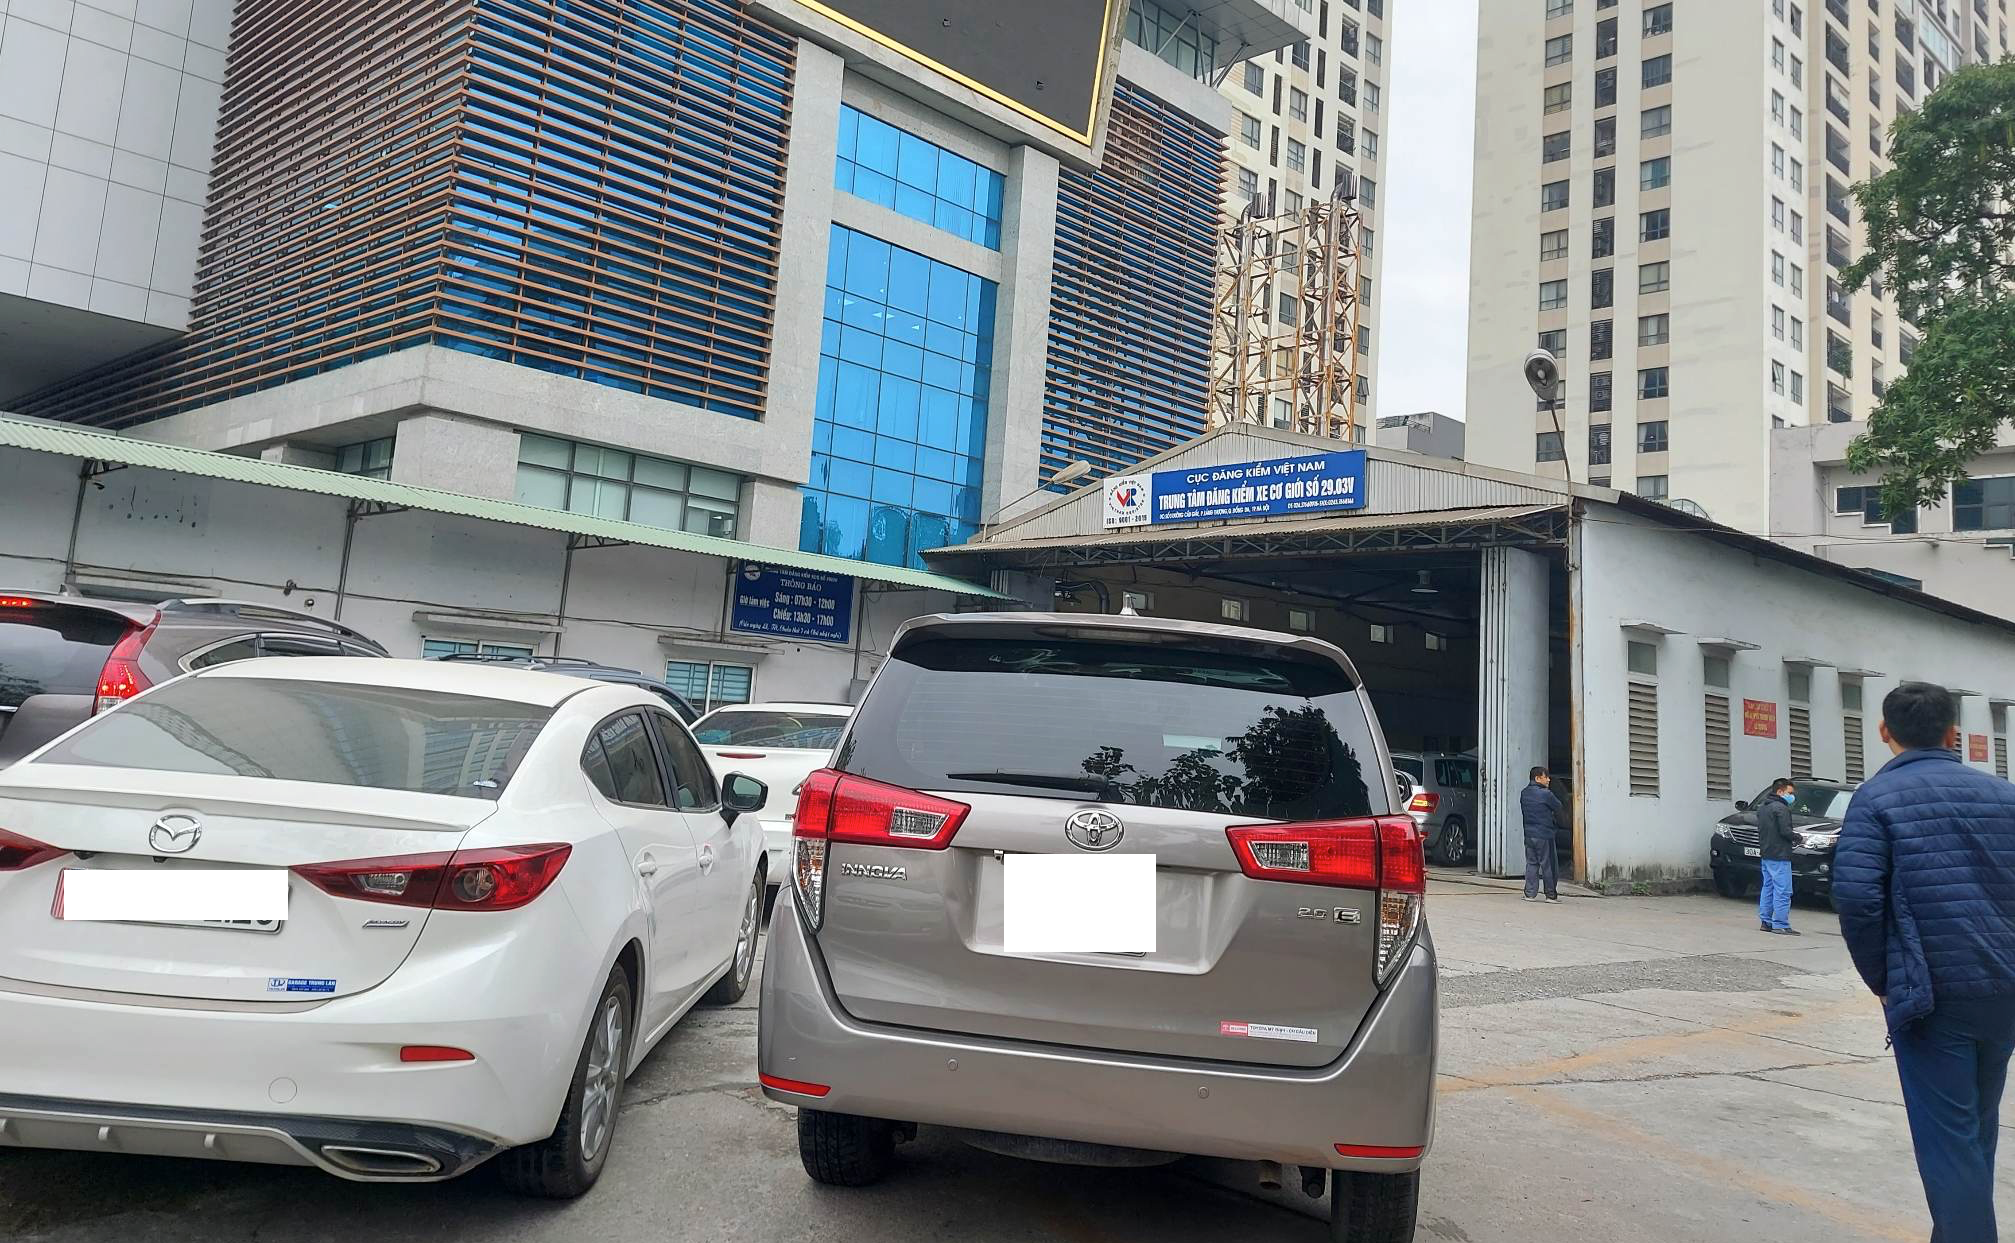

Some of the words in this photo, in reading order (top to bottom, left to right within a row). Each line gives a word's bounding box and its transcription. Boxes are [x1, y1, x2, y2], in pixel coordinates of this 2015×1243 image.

[1186, 473, 1209, 486] CỤC
[1212, 470, 1243, 482] ĐĂNG
[1246, 463, 1270, 478] KIỂM
[1274, 462, 1295, 476] VIỆT
[1298, 461, 1325, 472] NAM
[1158, 493, 1186, 510] TRUNG
[1187, 489, 1204, 508] TÂM
[1206, 486, 1230, 506] ĐĂNG
[1232, 480, 1254, 504] KIỂM
[1256, 485, 1268, 502] XE
[1270, 482, 1282, 500] CƠ
[1285, 478, 1304, 499] GIỚI
[1306, 474, 1319, 497] SỐ
[1321, 477, 1354, 496] 29.03V
[780, 578, 806, 589] THÔNG
[807, 581, 822, 592] BÁO
[774, 592, 790, 606] Sáng
[795, 594, 812, 607] 07h30
[818, 598, 835, 610] 12h00
[793, 611, 811, 624] 13h30
[817, 614, 834, 627] 17h00
[841, 863, 908, 880] INNOVA
